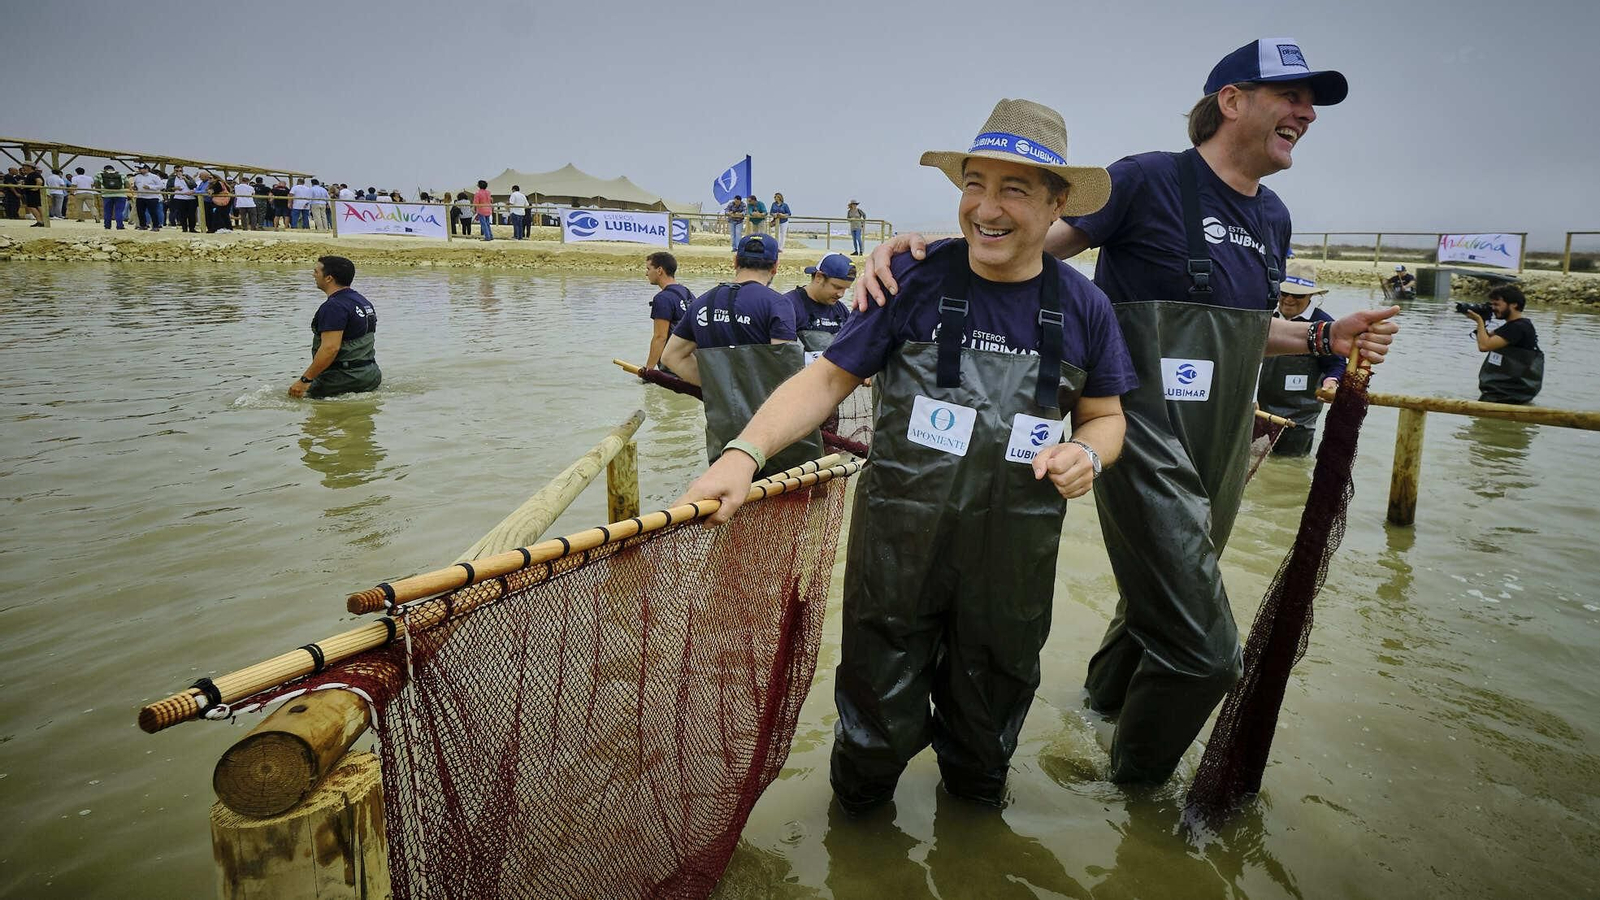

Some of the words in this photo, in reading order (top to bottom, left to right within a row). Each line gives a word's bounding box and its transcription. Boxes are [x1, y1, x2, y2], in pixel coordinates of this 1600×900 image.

[1030, 146, 1060, 165] LUBIM
[605, 221, 666, 236] LUBIMAR
[714, 314, 751, 324] LUBAR
[972, 330, 1006, 343] ESTEROS
[1165, 388, 1206, 397] UBIMAR
[911, 429, 967, 450] APONIENTE
[1011, 448, 1037, 460] LUBI
